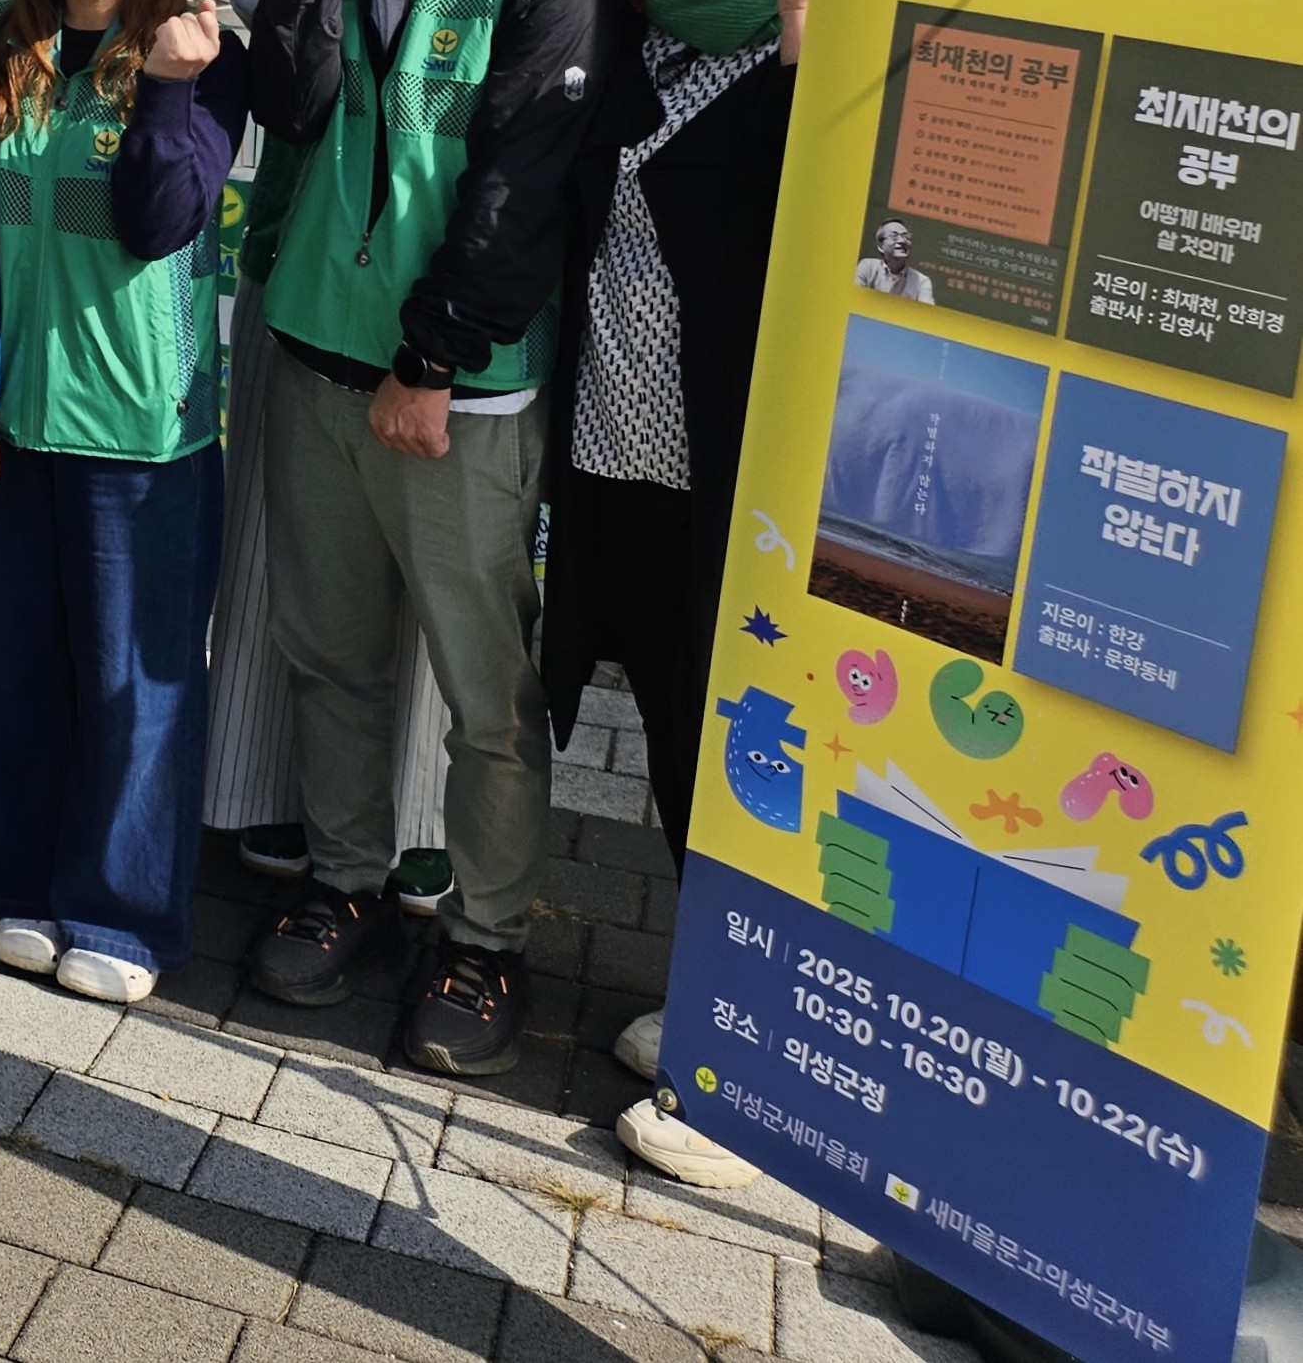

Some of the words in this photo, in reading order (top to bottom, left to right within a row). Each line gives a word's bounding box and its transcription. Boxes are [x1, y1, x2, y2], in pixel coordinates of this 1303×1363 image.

[420, 57, 458, 73] SMU
[915, 40, 1014, 81] 최재천의
[1019, 57, 1070, 91] 공부
[1134, 85, 1301, 152] 최재천의
[84, 157, 110, 174] SM
[1177, 144, 1240, 190] 공부
[1139, 198, 1199, 235] 어떻게
[1200, 209, 1262, 245] 배우며
[1156, 228, 1180, 252] 살
[1180, 232, 1236, 266] 것인가
[1089, 296, 1145, 326] 출판사
[1157, 310, 1215, 343] 김영사
[1093, 271, 1147, 302] 지은이
[1161, 287, 1222, 322] 최재천,
[1227, 302, 1285, 335] 안희경
[1079, 443, 1241, 528] 작별하지
[1101, 503, 1200, 567] 않는다
[1036, 623, 1092, 660] 출판사
[1103, 647, 1177, 692] 문학동네
[1041, 600, 1095, 636] 지은이
[1108, 621, 1146, 653] 한강
[710, 997, 761, 1046] 장소
[782, 1035, 887, 1115] 의성군청
[725, 909, 776, 960] 일시
[1055, 1076, 1206, 1181] 10.22(수)
[792, 985, 874, 1048] 10:30
[899, 1040, 988, 1108] 16:30
[721, 1079, 870, 1183] 의성군새마을회
[923, 1194, 1173, 1352] 새마을문고의성군지부
